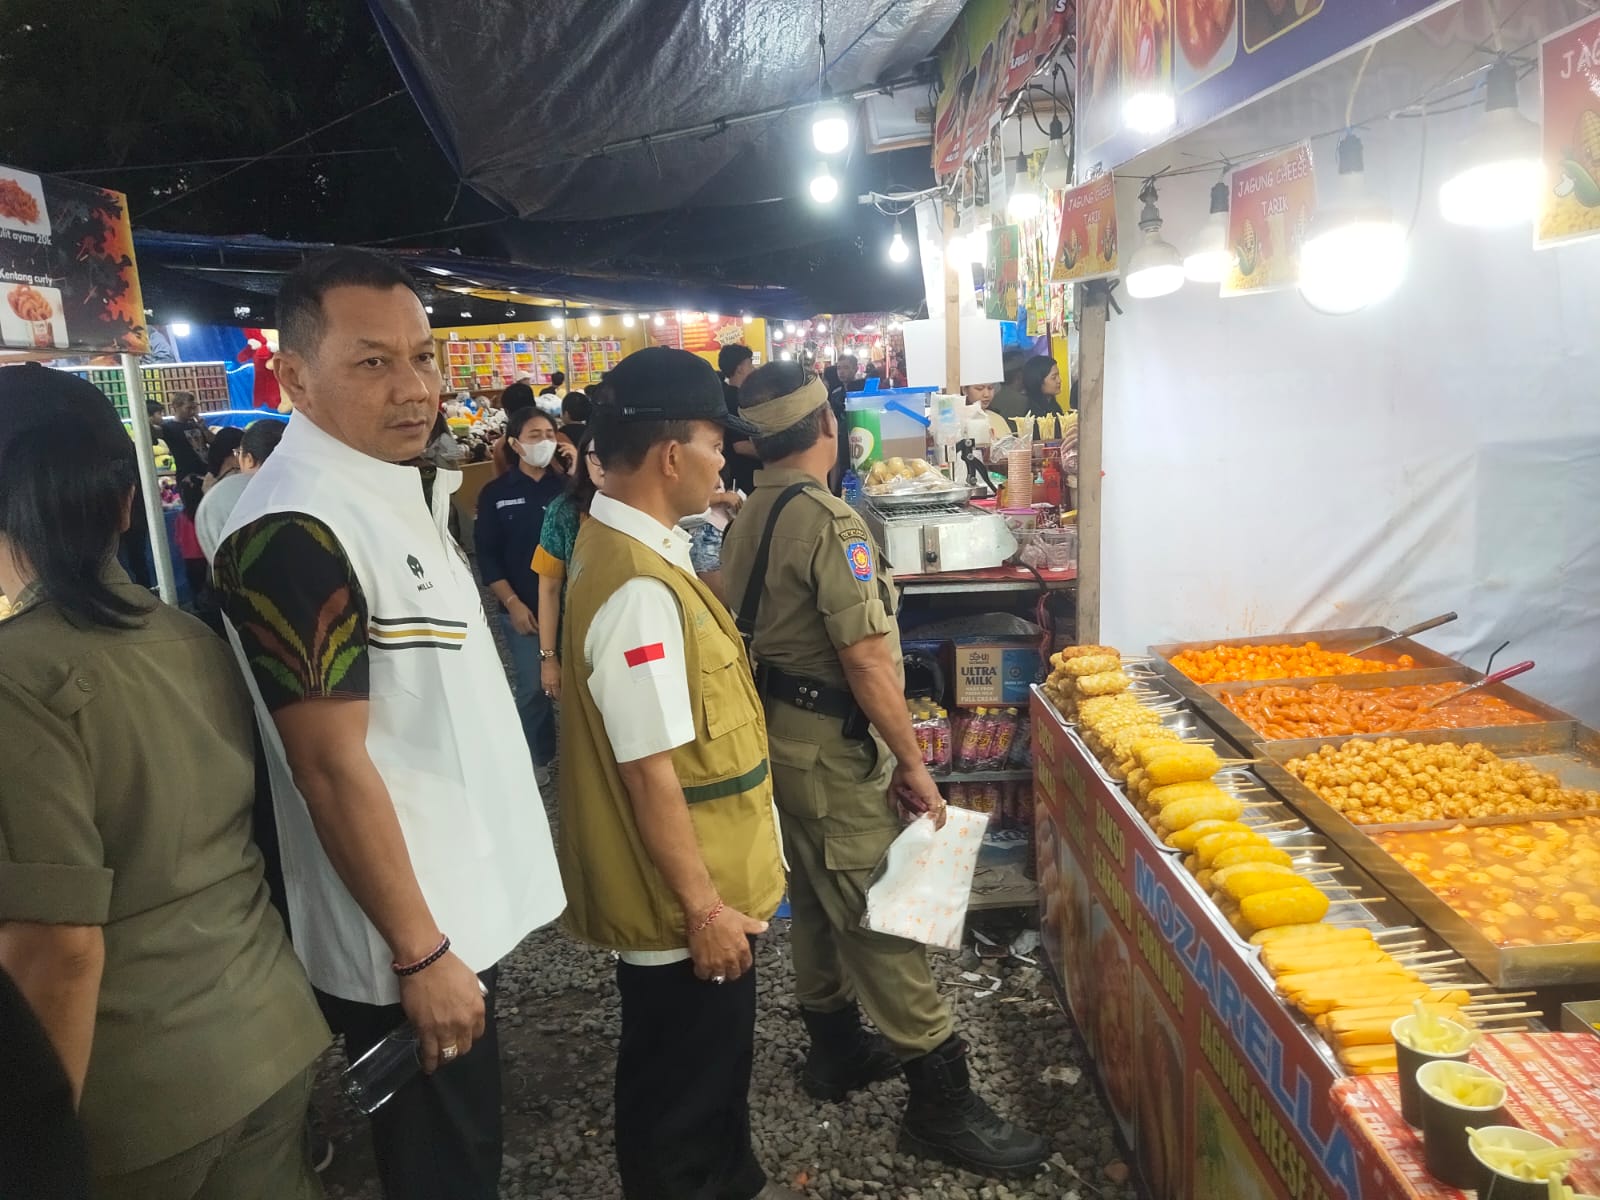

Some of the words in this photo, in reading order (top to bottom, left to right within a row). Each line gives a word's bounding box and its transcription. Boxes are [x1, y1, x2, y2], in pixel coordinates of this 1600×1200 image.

[1238, 170, 1274, 198] JAGUNG
[1261, 195, 1289, 216] TARIK
[12, 231, 35, 244] ayam
[0, 267, 33, 285] Kentang
[34, 273, 52, 287] curly
[416, 581, 434, 592] MILLS
[961, 666, 997, 676] ULTRA
[965, 676, 993, 685] MILK
[1134, 848, 1362, 1200] MOZARELLA
[1200, 1004, 1248, 1120] JAGUNG
[1360, 1111, 1441, 1199] FRAGILE
